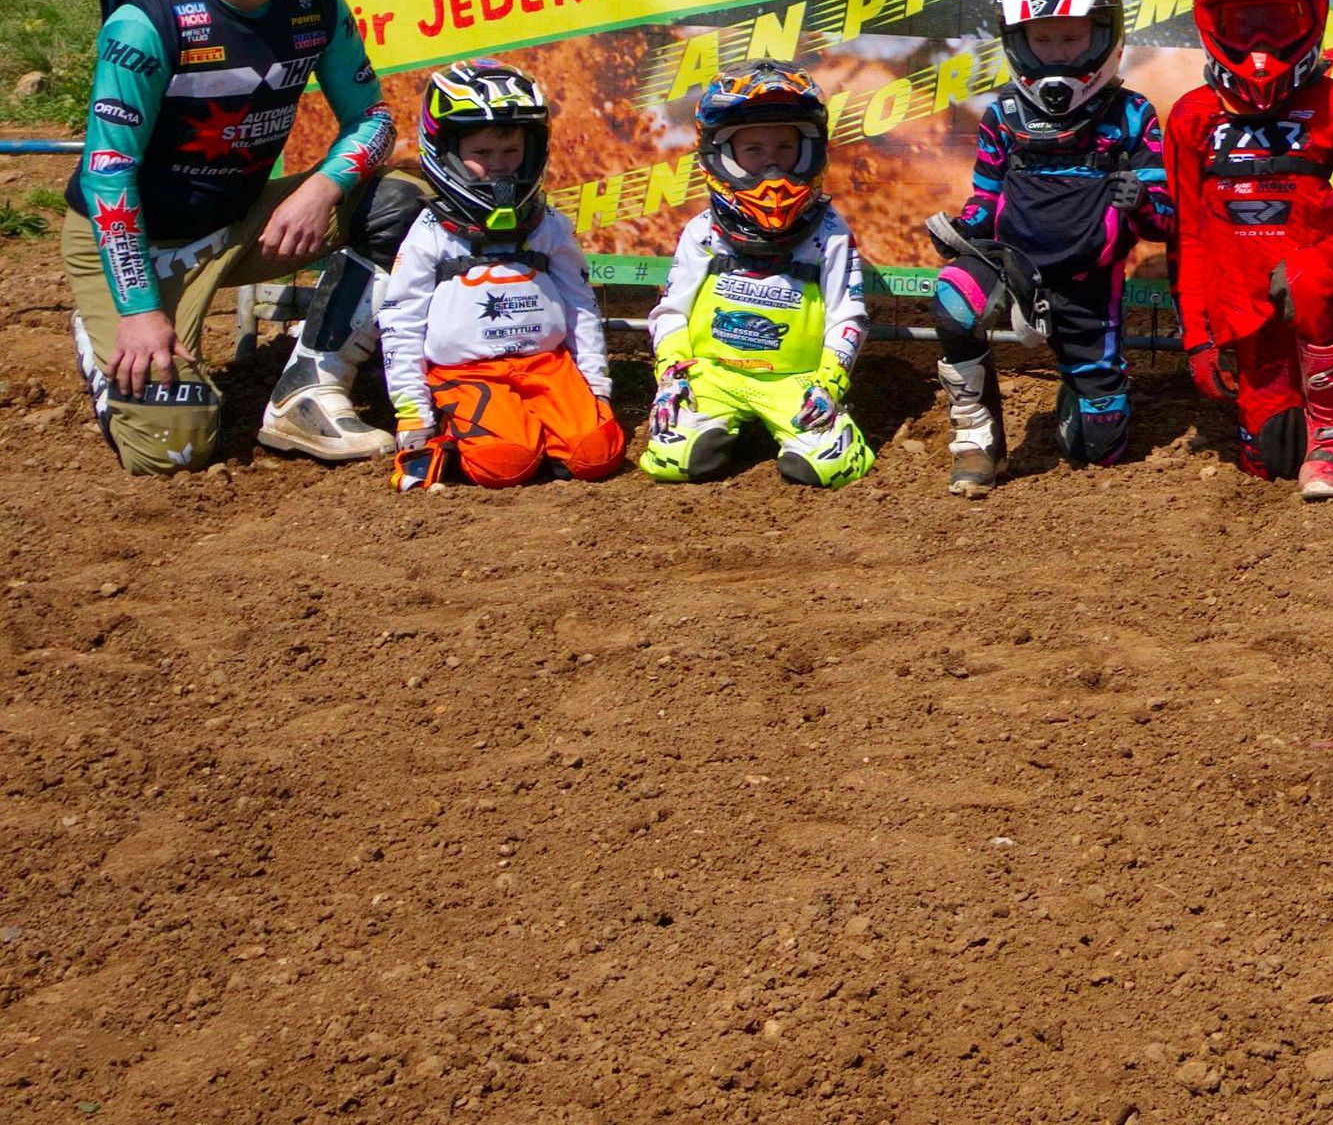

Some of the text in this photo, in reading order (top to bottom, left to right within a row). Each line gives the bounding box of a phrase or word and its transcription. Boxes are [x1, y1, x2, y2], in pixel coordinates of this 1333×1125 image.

[95, 102, 139, 125] ORTEMA
[242, 103, 296, 124] AUTOHA
[110, 221, 138, 290] STEINER
[127, 232, 150, 290] AUTOHAUS
[714, 276, 803, 305] STEINIGER
